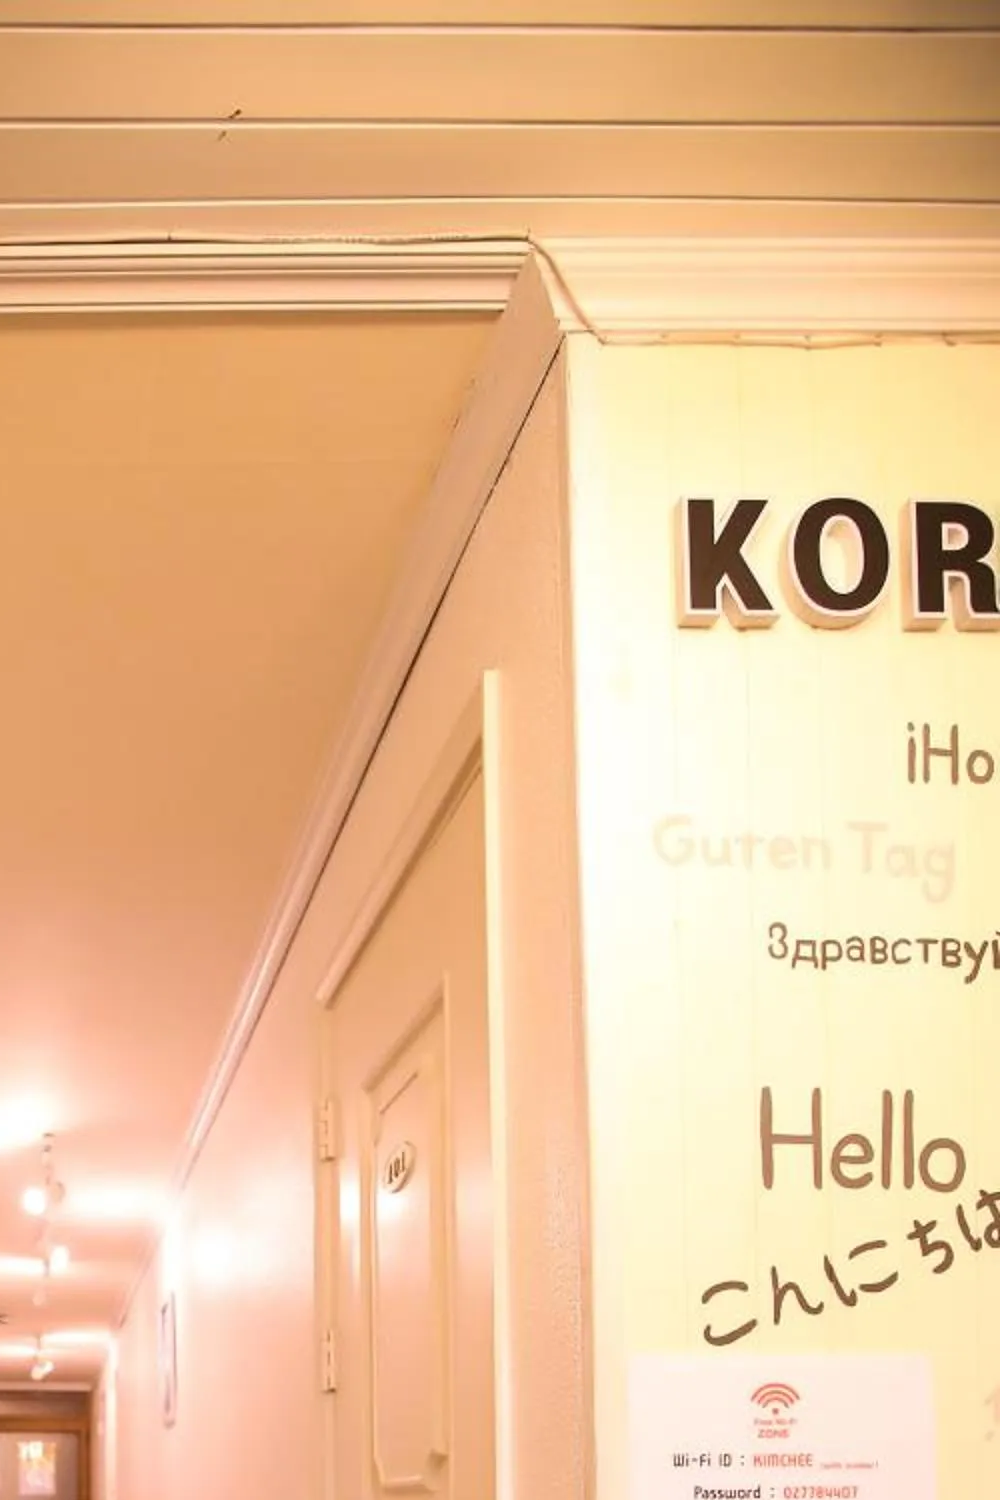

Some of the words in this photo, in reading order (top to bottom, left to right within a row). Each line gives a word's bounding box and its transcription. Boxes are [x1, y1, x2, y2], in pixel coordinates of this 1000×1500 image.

[677, 496, 1000, 631] KOR
[652, 813, 832, 871] Guten
[845, 820, 956, 903] Tag
[760, 1086, 966, 1192] Hello
[757, 1429, 789, 1438] ZONE
[673, 1453, 711, 1467] Wi-Fi
[718, 1453, 732, 1467] ID
[753, 1453, 813, 1467] KIMCHEE
[694, 1485, 761, 1500] Password
